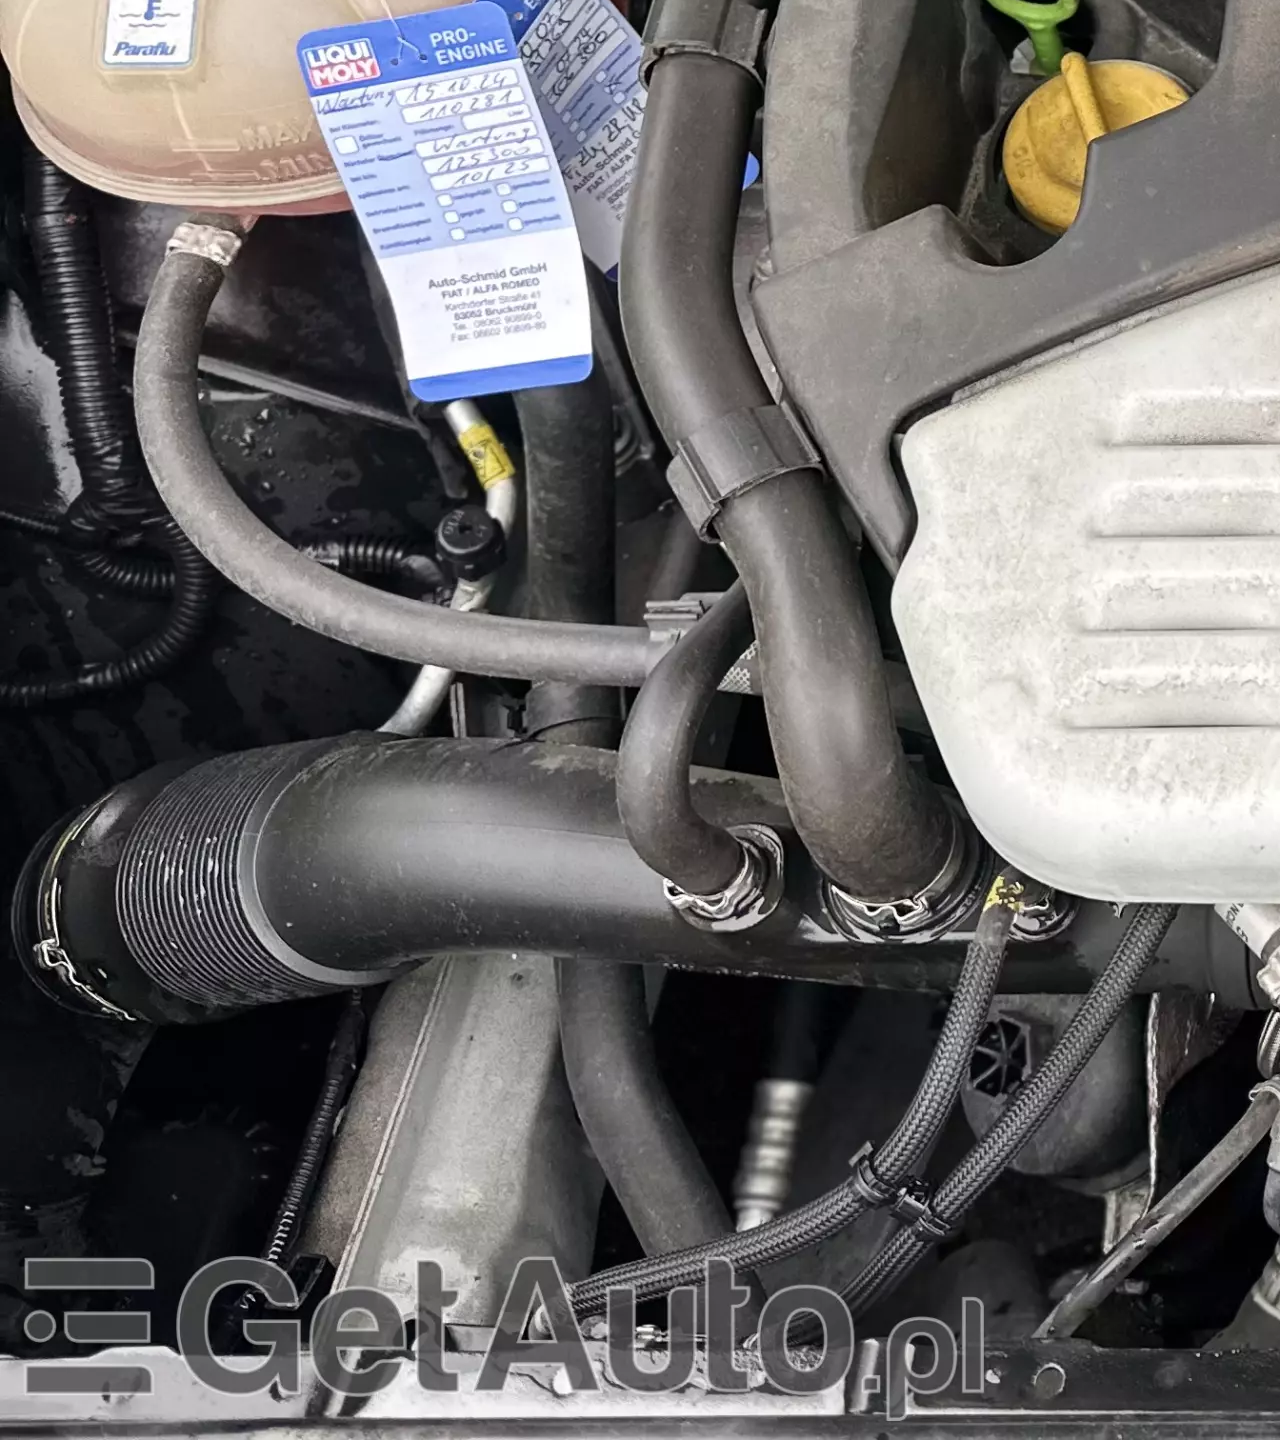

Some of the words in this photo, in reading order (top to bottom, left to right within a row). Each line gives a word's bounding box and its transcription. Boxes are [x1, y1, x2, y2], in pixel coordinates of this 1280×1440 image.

[430, 27, 477, 49] PRO-
[308, 40, 370, 65] LIQUI
[435, 39, 508, 65] ENGINE
[311, 59, 380, 87] MOLY
[428, 269, 506, 289] Auto-Schmid
[510, 262, 547, 277] GmbH
[441, 288, 463, 299] FIAT
[473, 283, 499, 295] ALFA
[501, 277, 540, 291] ROMEO
